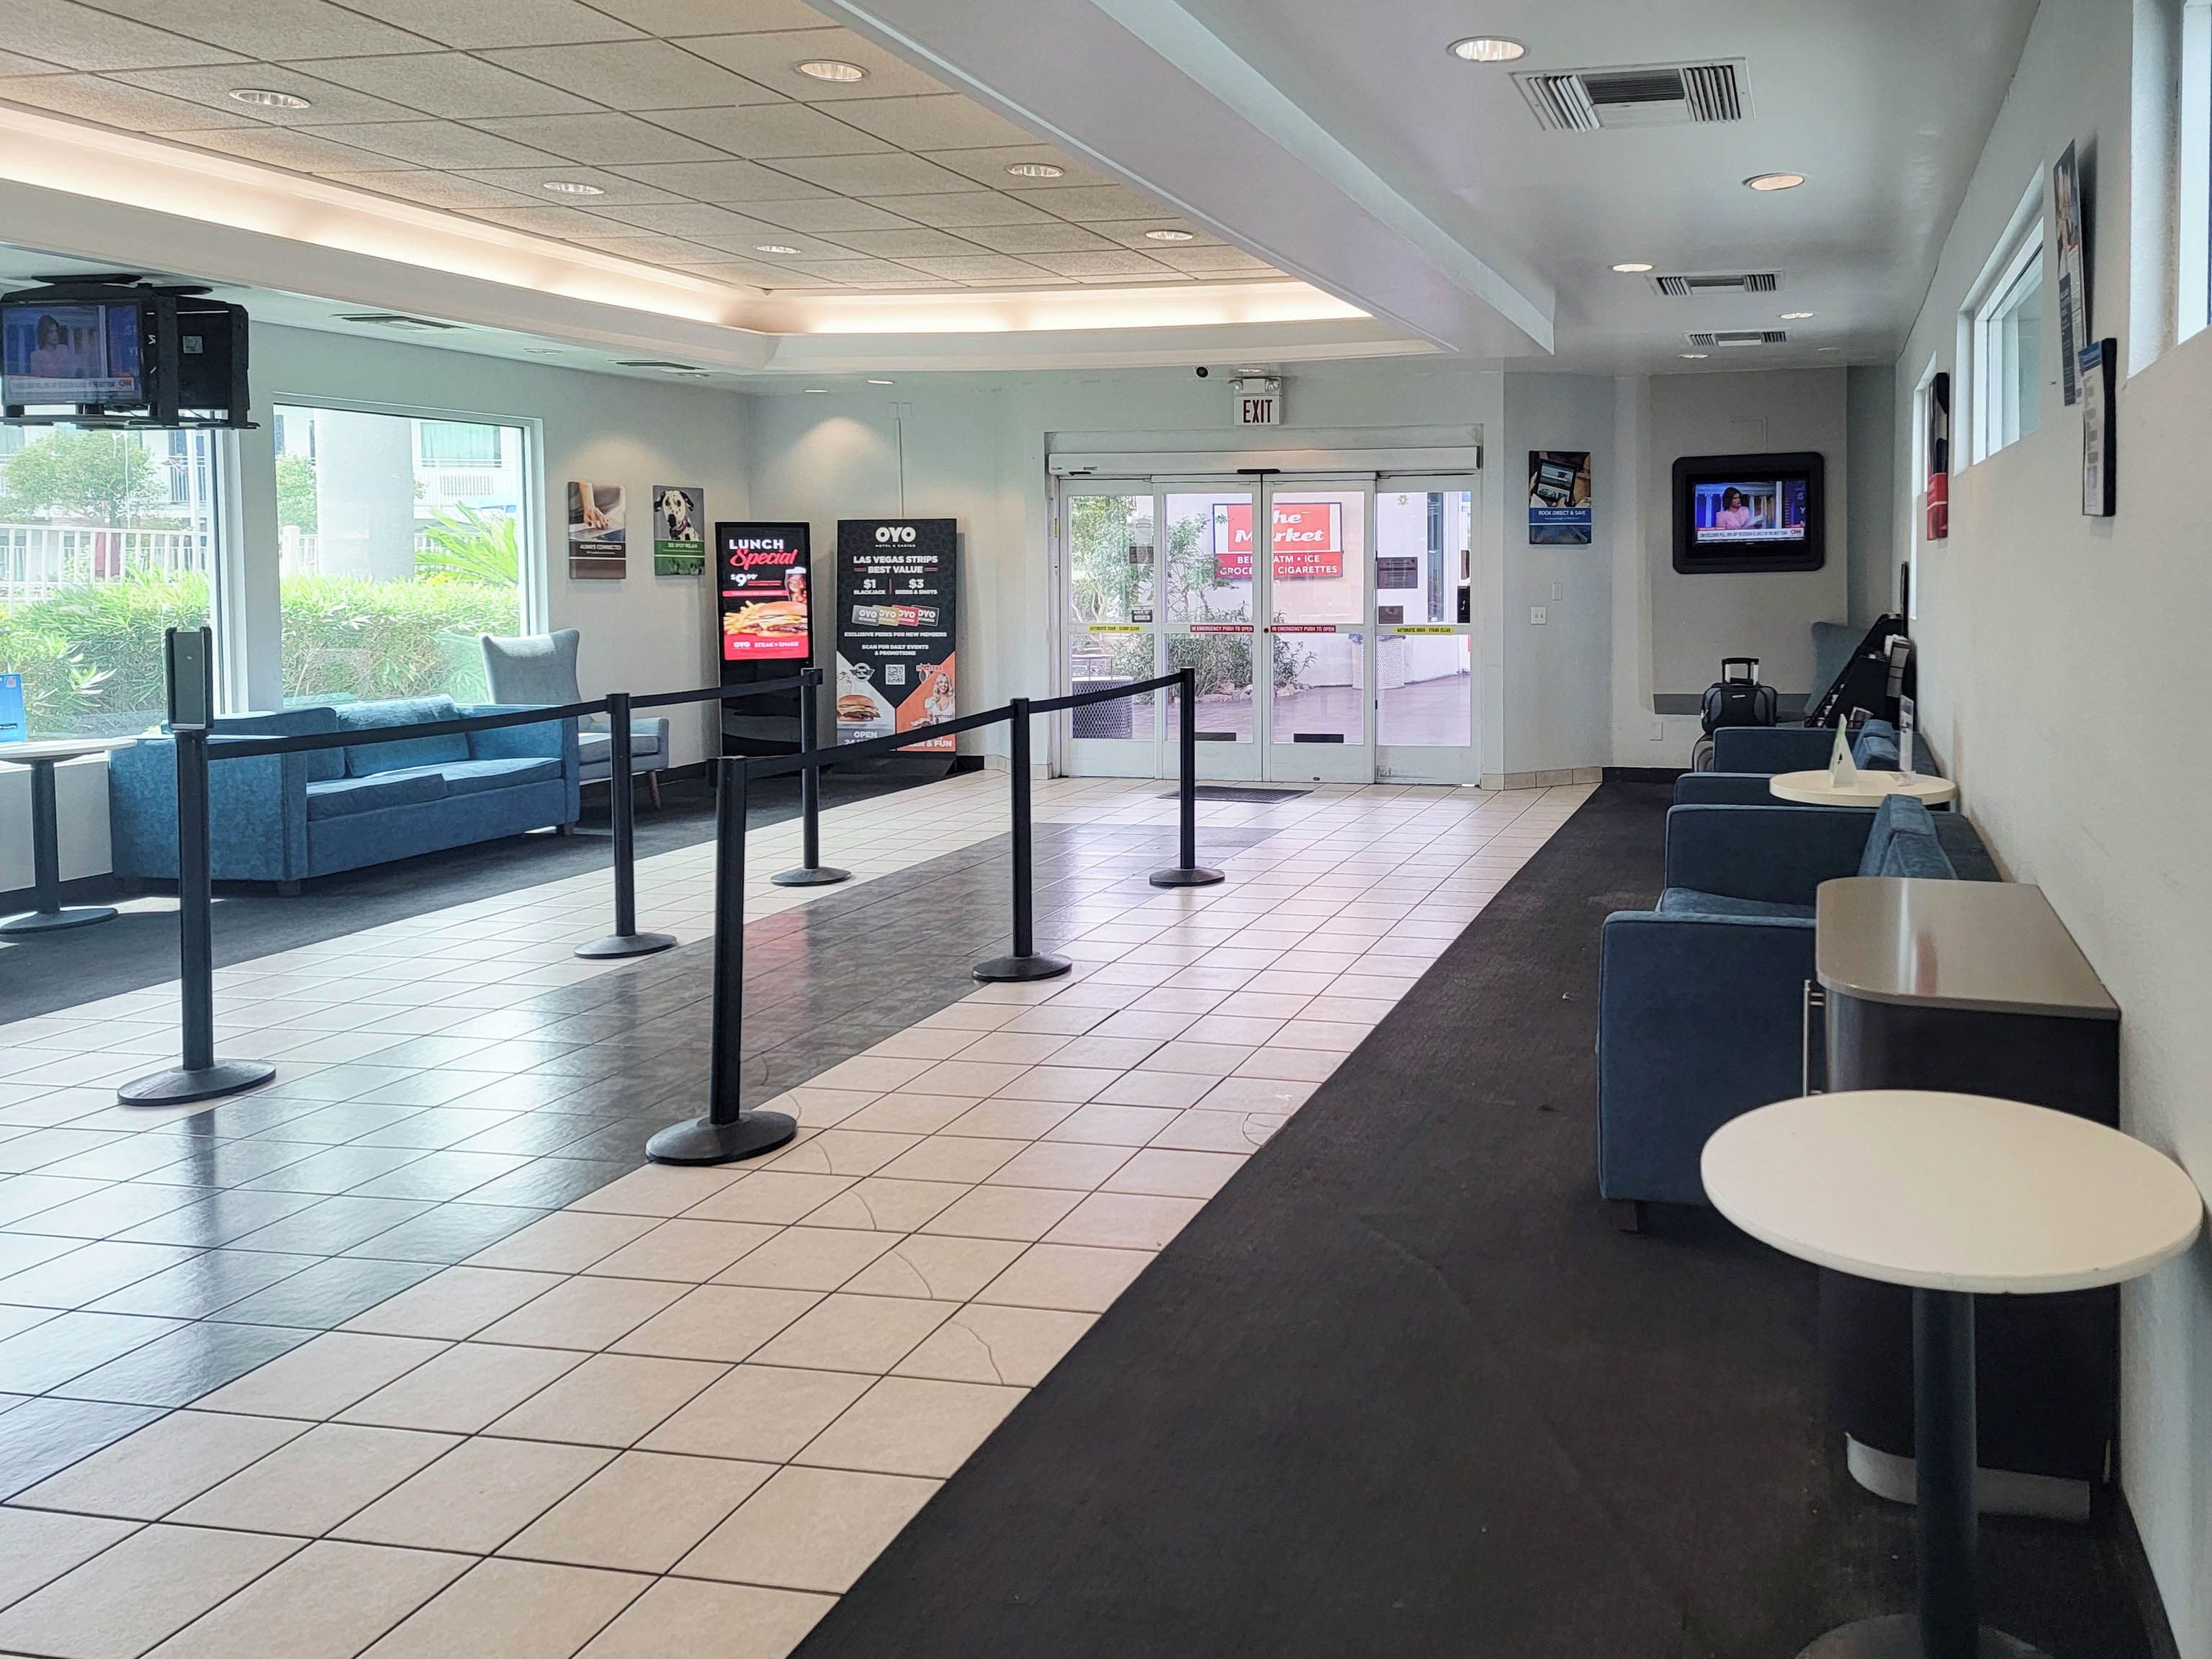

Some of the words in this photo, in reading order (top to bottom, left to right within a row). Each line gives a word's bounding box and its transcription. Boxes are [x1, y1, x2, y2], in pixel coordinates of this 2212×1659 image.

[1244, 400, 1272, 423] EXIT
[1273, 510, 1302, 524] he
[875, 526, 916, 542] OYO
[1234, 527, 1324, 543] Mrket
[729, 539, 784, 549] LUNCH
[729, 549, 799, 570] Special
[1277, 565, 1338, 575] CIGARETTES
[863, 578, 876, 589] $1
[909, 578, 925, 589] $3
[858, 609, 878, 619] OYO
